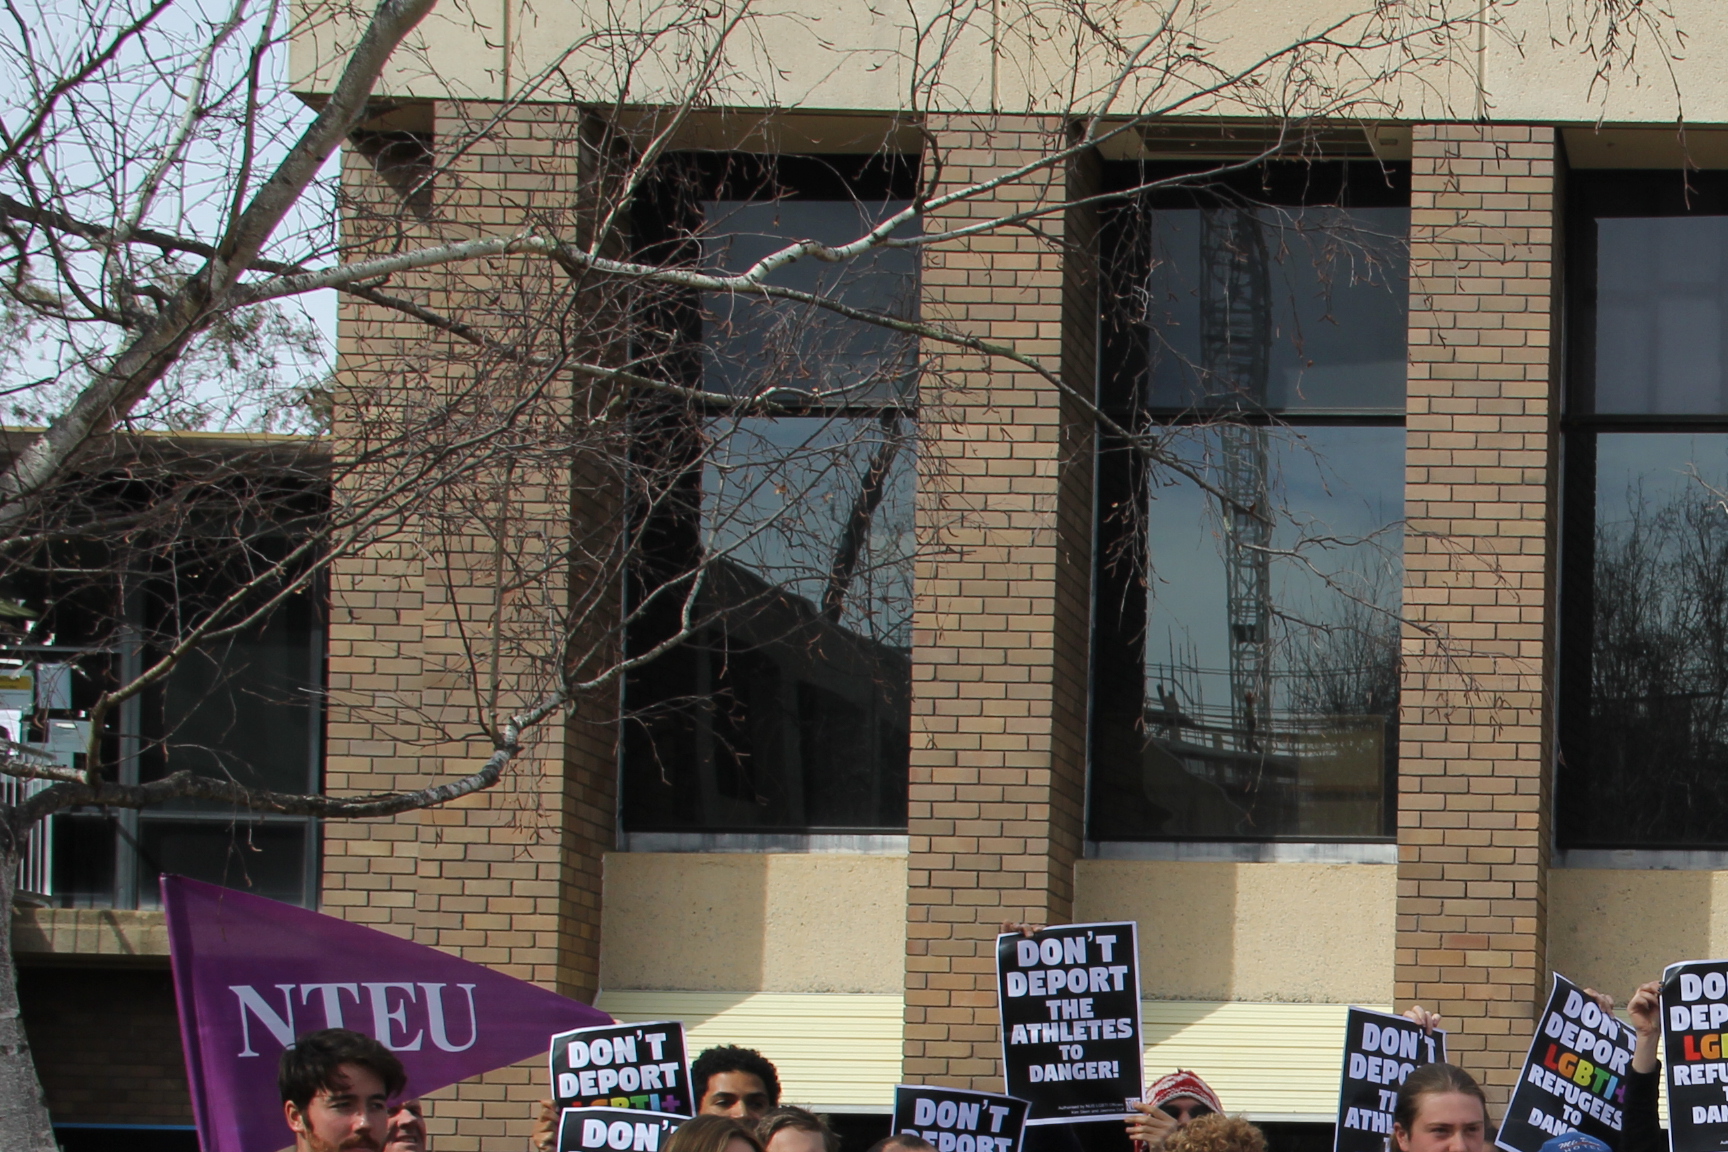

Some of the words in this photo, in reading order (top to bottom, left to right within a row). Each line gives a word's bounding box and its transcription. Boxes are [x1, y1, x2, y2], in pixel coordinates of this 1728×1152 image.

[1017, 931, 1117, 967] DON'T
[1006, 965, 1128, 997] DEPORT
[228, 982, 479, 1058] NTEU
[1045, 998, 1094, 1020] THE
[1010, 1018, 1133, 1045] ATHLETES
[1361, 1022, 1436, 1064] DON'T
[1545, 1011, 1634, 1076] DEPOR
[568, 1030, 666, 1069] DON'T
[1058, 1044, 1083, 1061] TO
[558, 1062, 679, 1098] DEPORT
[1029, 1060, 1120, 1083] DANGER!
[1527, 1063, 1622, 1131] REFUGEES
[914, 1098, 1009, 1133] DON'T
[1344, 1107, 1394, 1134] ATHL
[1563, 1104, 1582, 1126] TO
[582, 1119, 678, 1152] DON'
